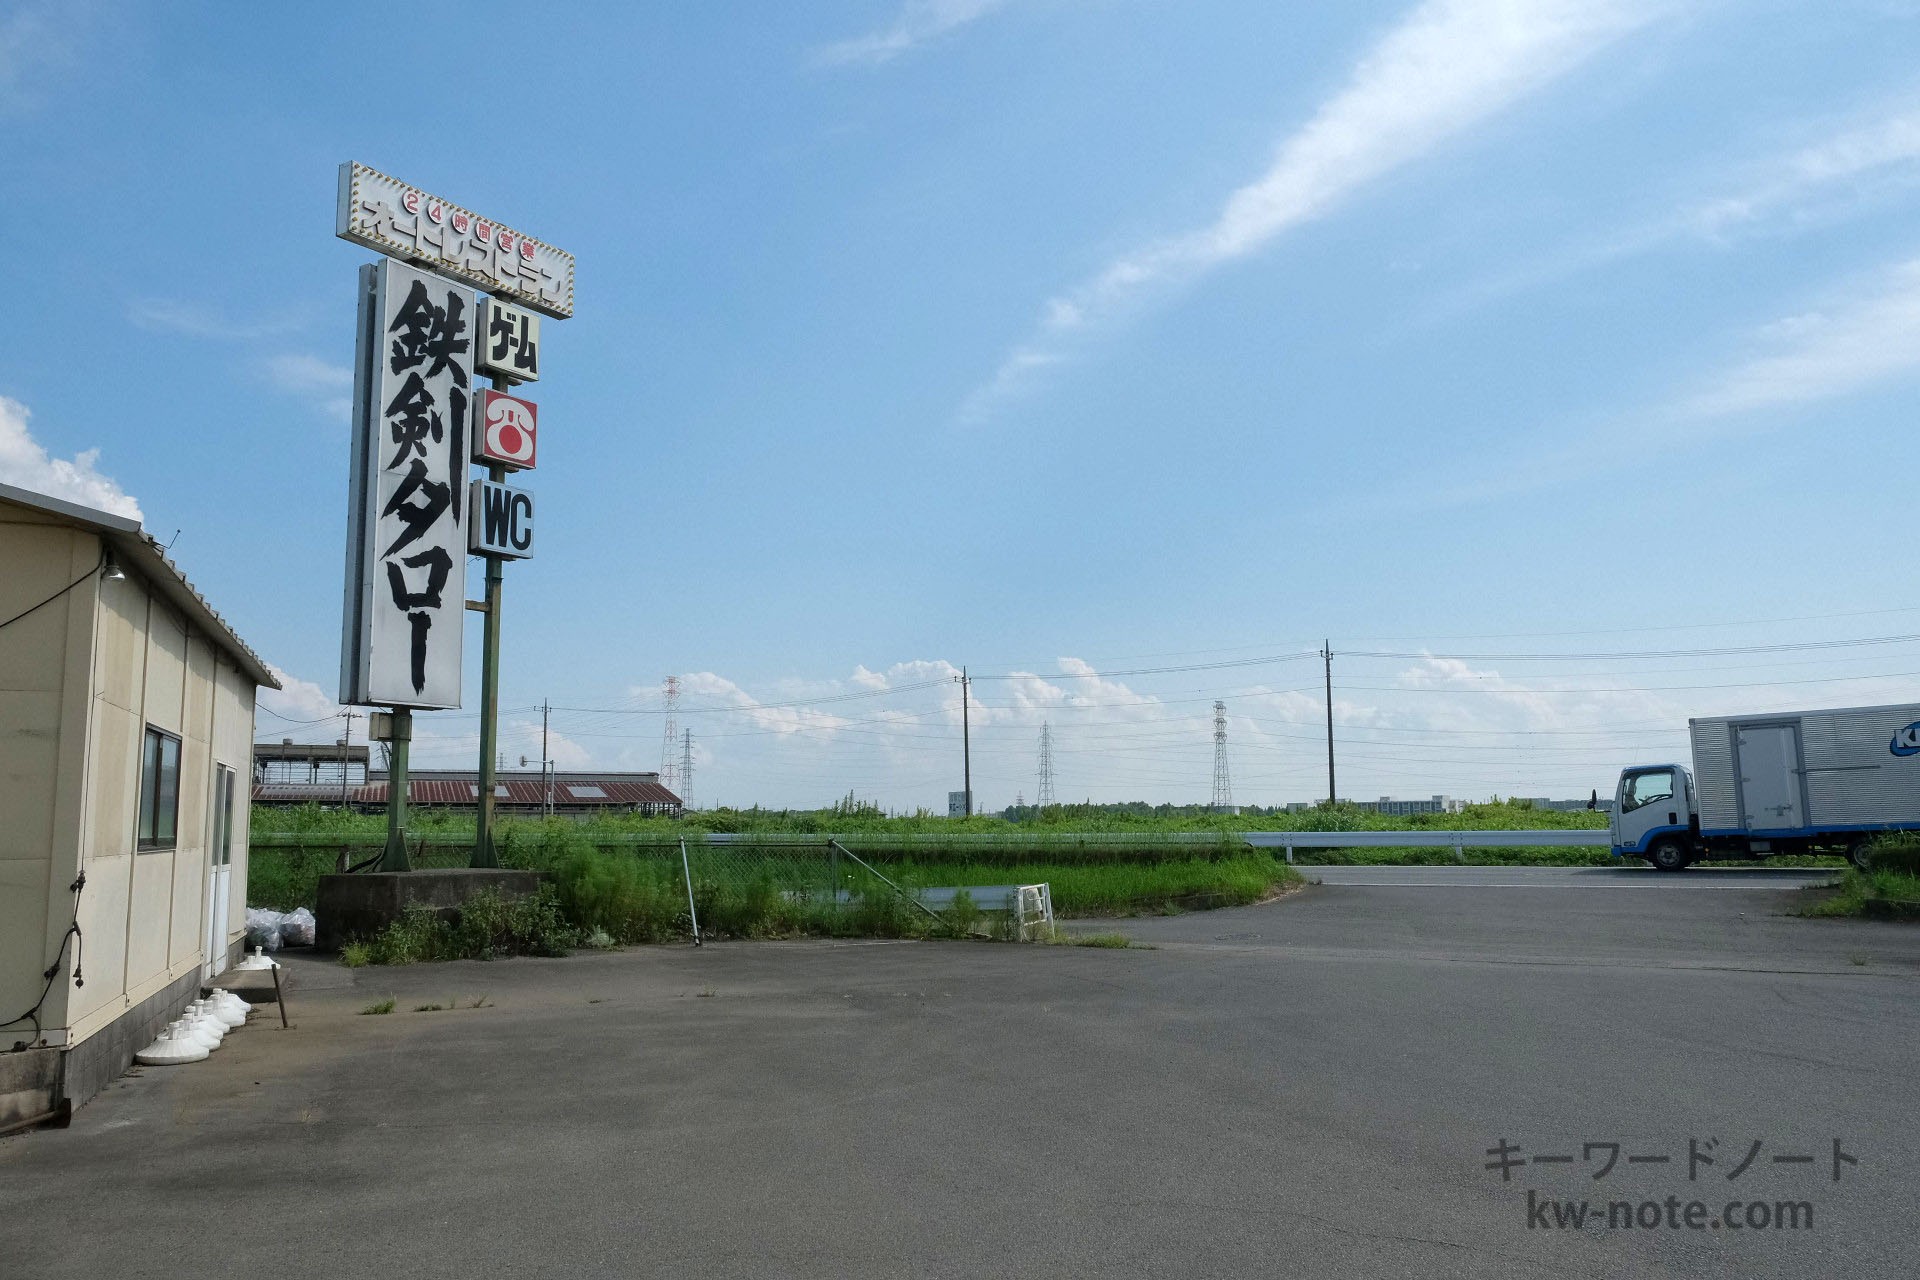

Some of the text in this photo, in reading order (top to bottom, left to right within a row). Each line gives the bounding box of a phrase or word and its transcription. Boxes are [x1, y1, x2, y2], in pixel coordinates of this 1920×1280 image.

[362, 200, 561, 303] オートレストラン
[405, 192, 537, 260] 24時間営業
[490, 305, 537, 374] ゲーム
[380, 279, 470, 696] 鉄剣タロー
[484, 485, 532, 551] WC
